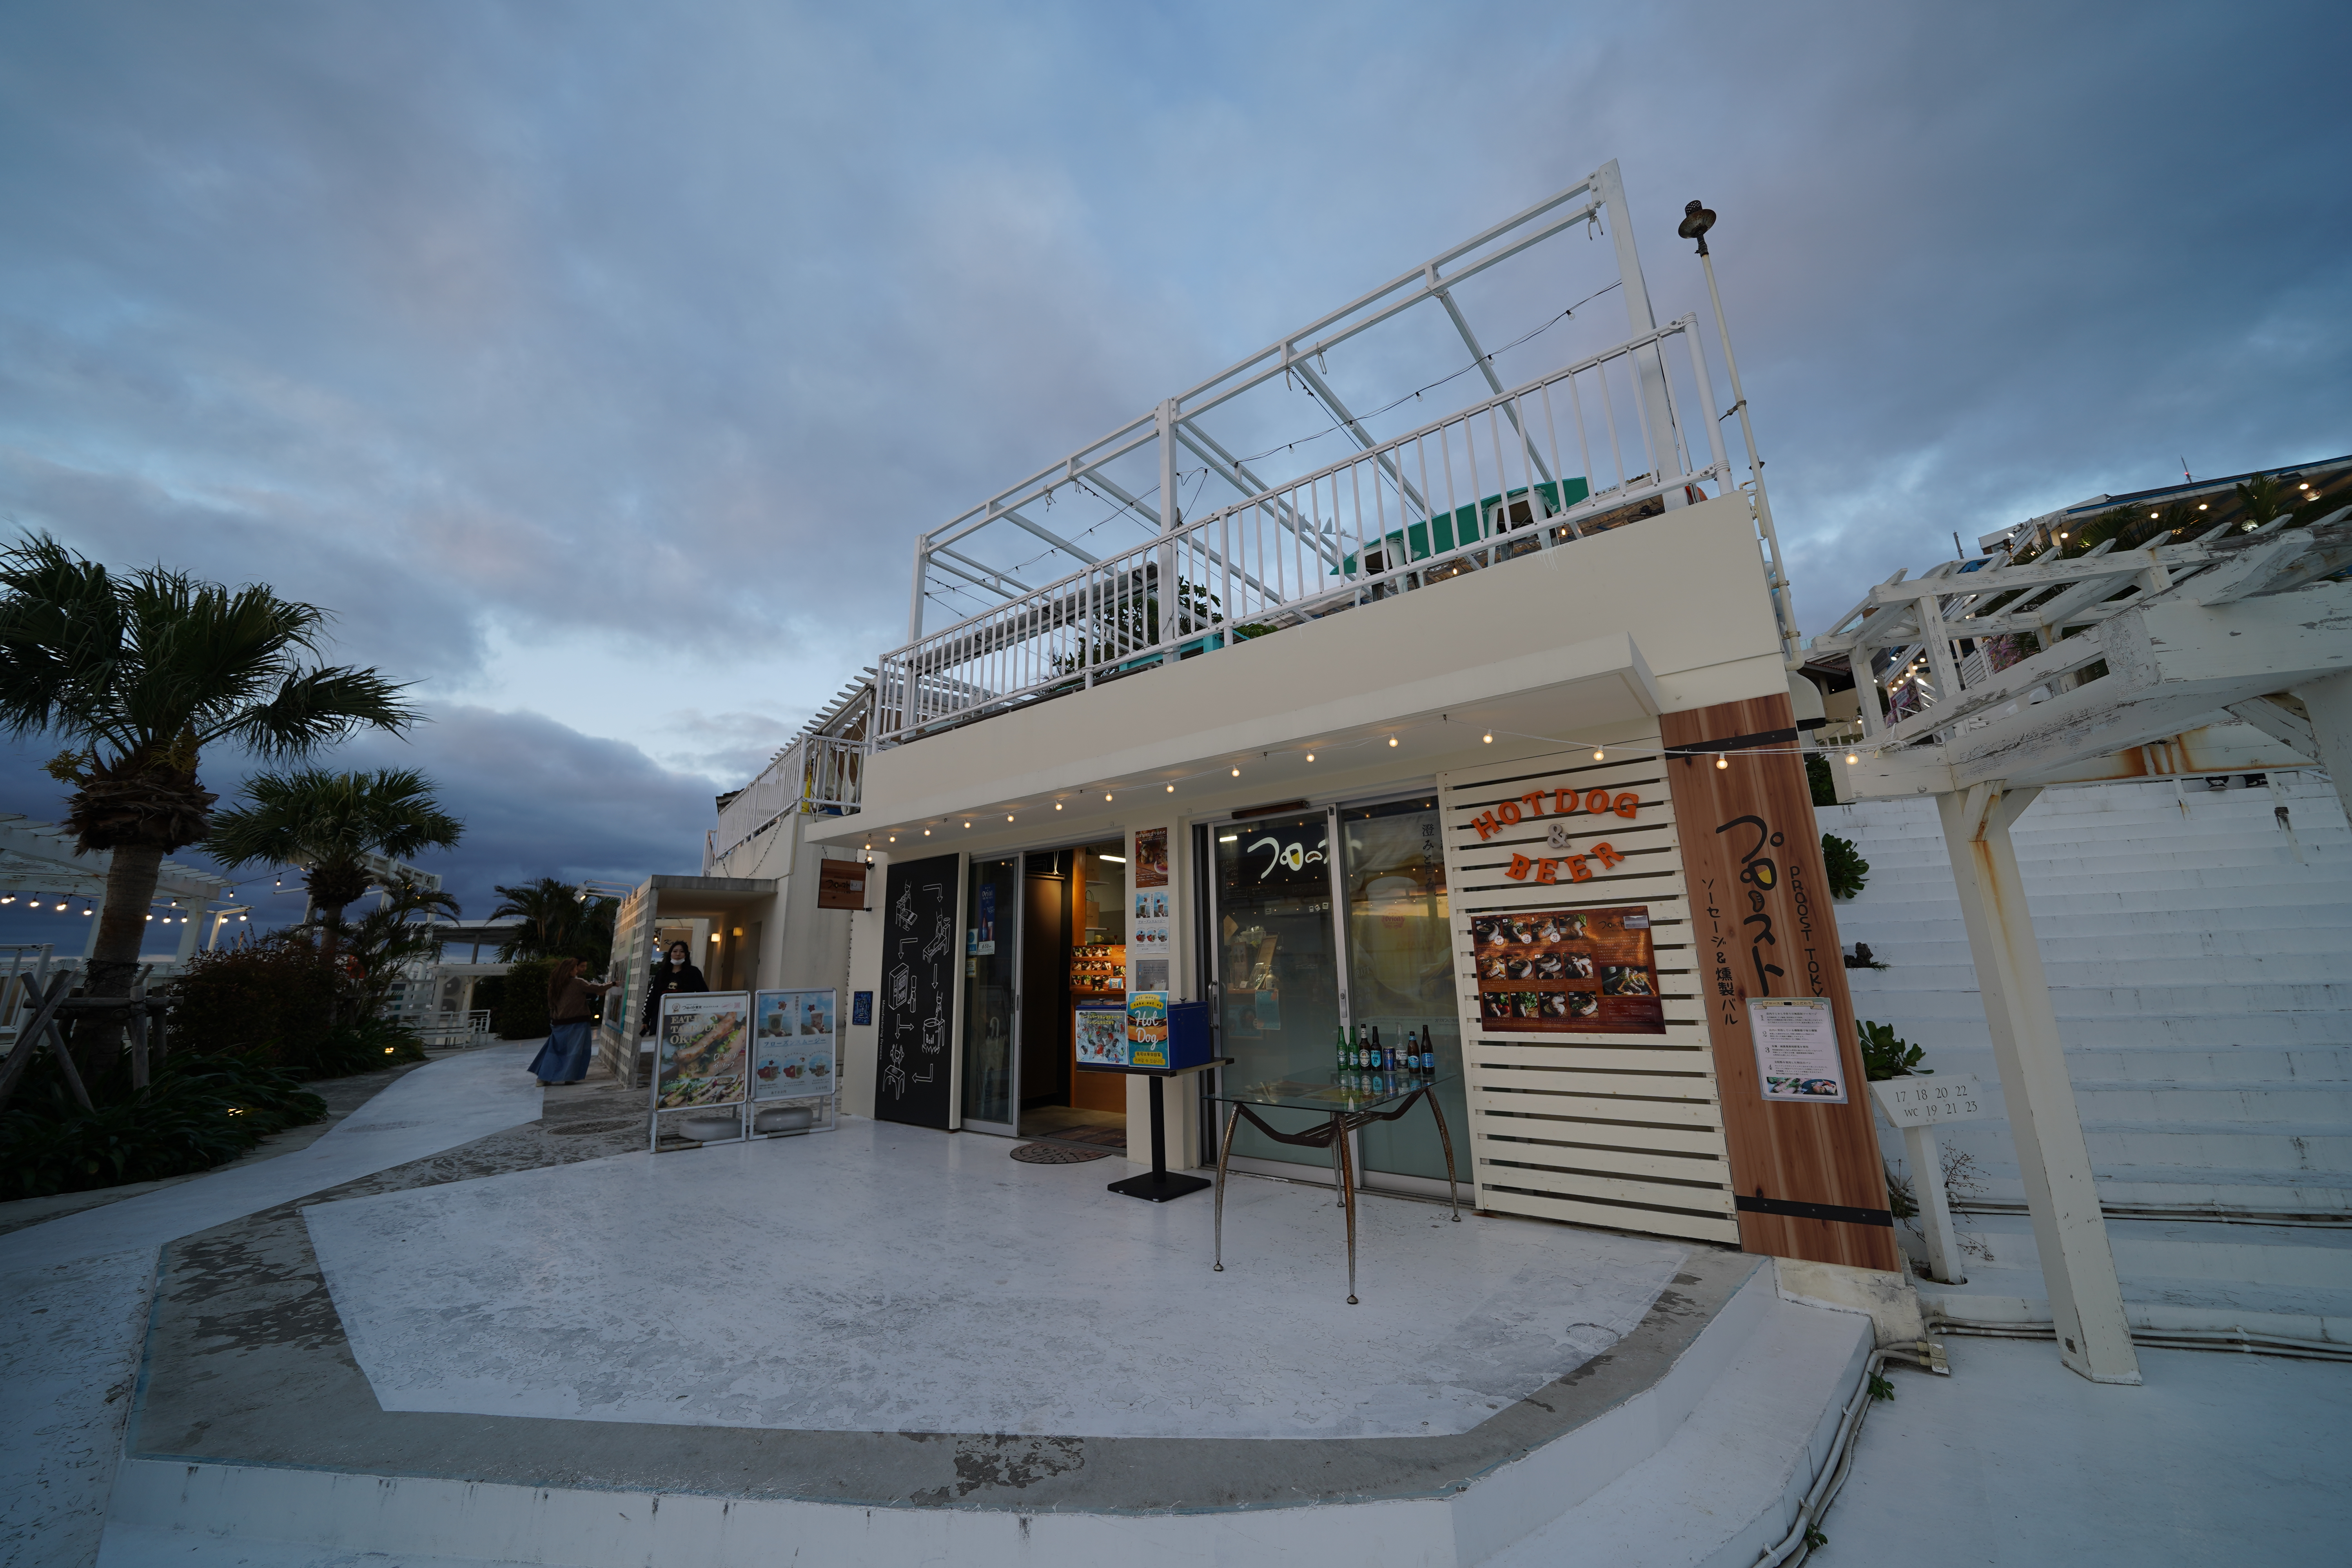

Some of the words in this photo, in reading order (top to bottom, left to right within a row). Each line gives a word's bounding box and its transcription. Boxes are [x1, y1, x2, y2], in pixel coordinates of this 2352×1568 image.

[1470, 789, 1639, 841] HOTDOG
[1547, 824, 1571, 848] &
[1505, 842, 1625, 884] BEER
[1790, 866, 1812, 941] PROOST
[1135, 1010, 1159, 1026] Hot
[671, 1024, 719, 1034] TAKEOUT
[670, 1034, 692, 1045] OK!
[764, 1038, 826, 1046] フローズンスムージー
[926, 1034, 934, 1044] Boil
[1136, 1027, 1159, 1051] Dog
[1896, 1091, 1906, 1102] 17
[1916, 1089, 1927, 1100] 18
[1935, 1087, 1948, 1098] 20
[1955, 1085, 1967, 1096] 22
[1904, 1108, 1918, 1117] WC
[1926, 1105, 1937, 1116] 19
[1945, 1103, 1957, 1114] 21
[1965, 1101, 1977, 1112] 23
